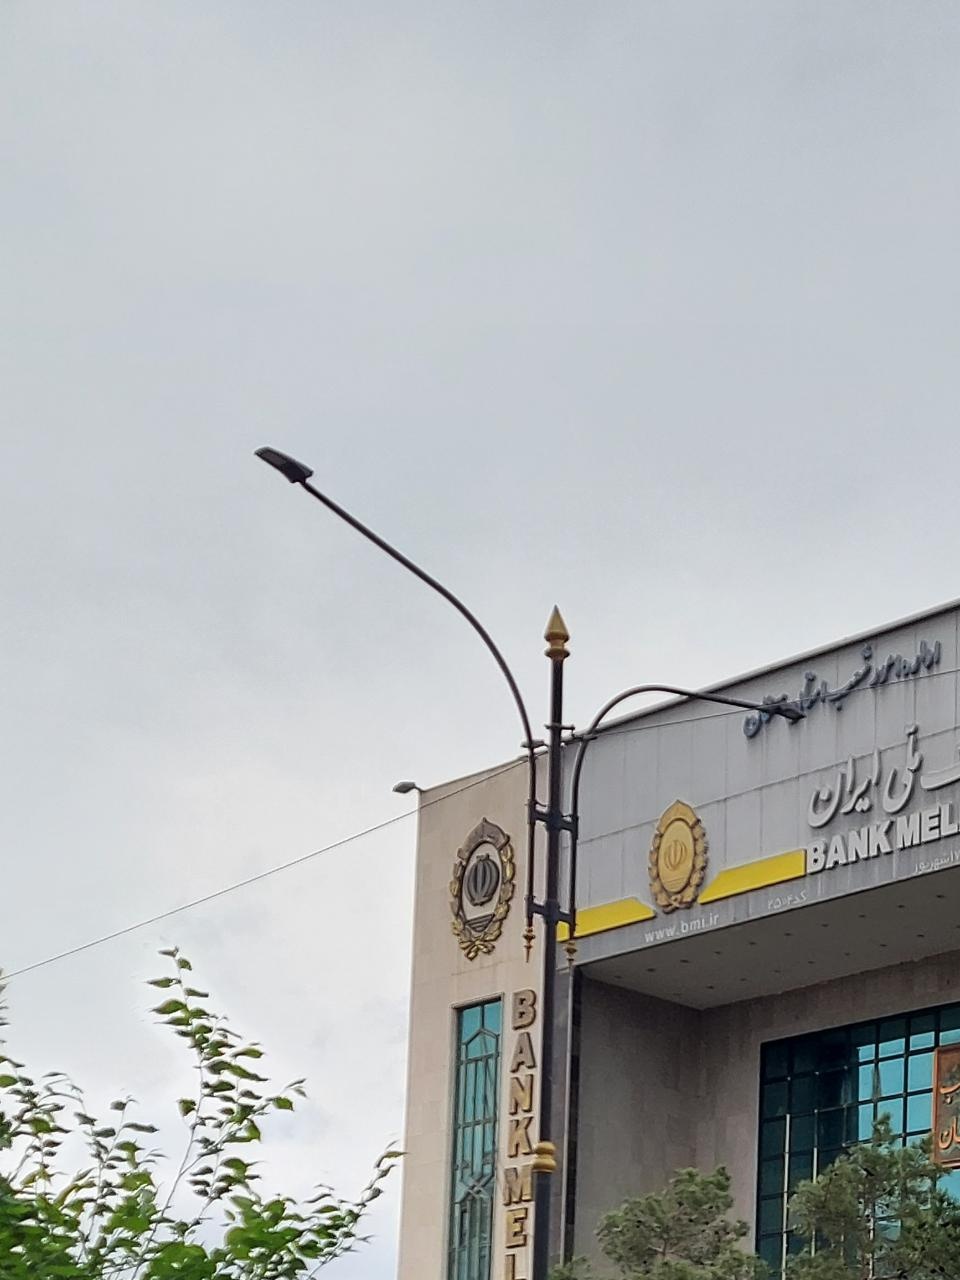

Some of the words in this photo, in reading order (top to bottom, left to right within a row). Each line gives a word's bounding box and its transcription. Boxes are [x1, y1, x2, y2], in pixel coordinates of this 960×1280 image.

[808, 749, 881, 828] ایران
[882, 724, 923, 814] ملی
[806, 819, 894, 875] BANK
[644, 912, 720, 942] www.bmi.ir
[508, 988, 537, 1159] BANK
